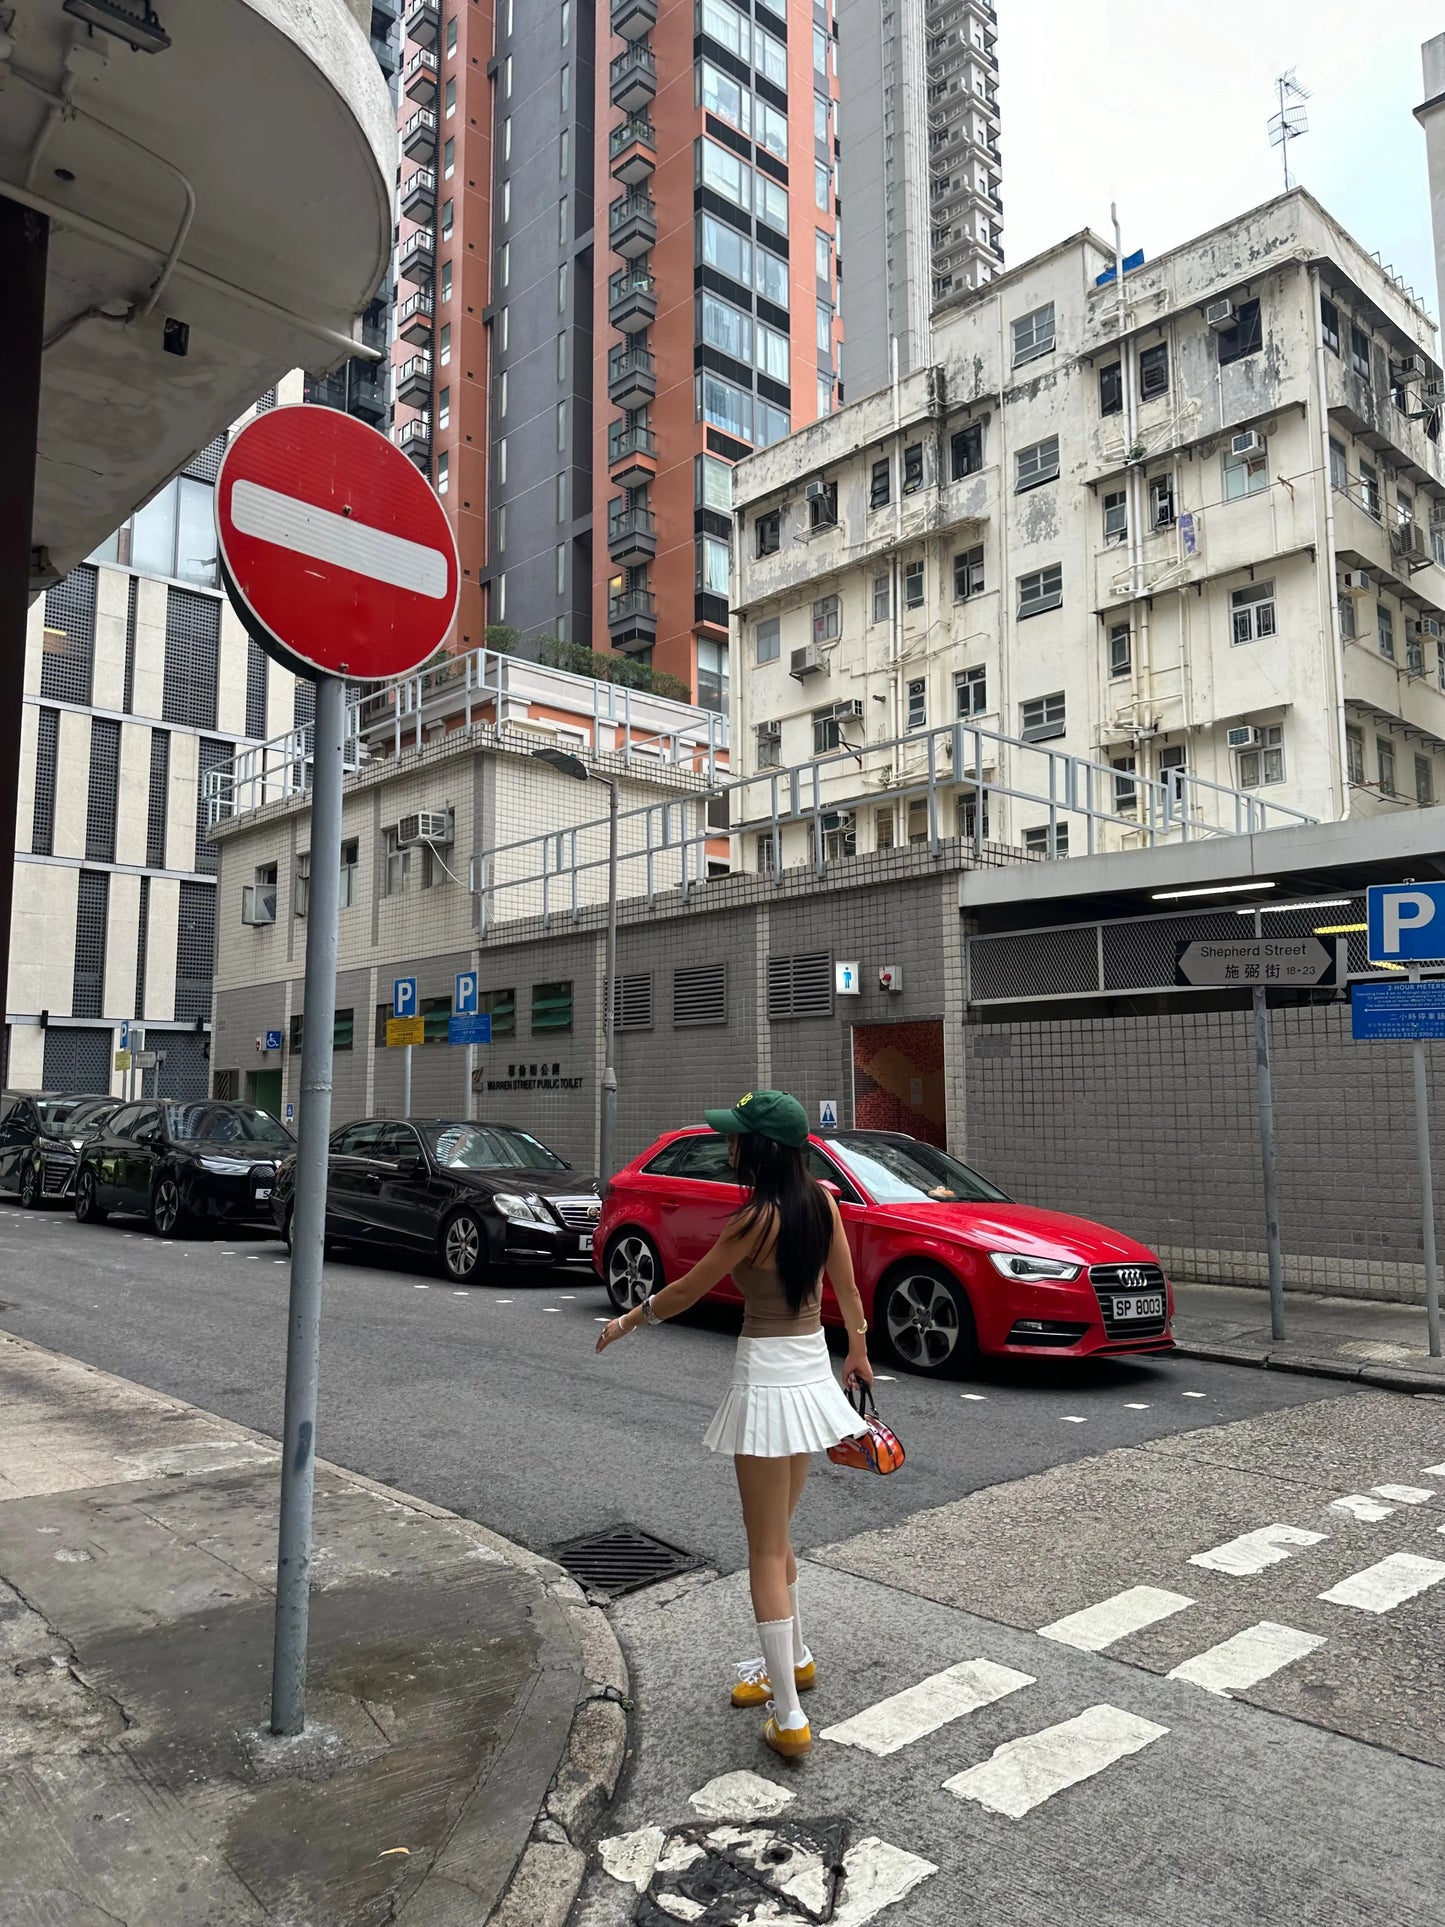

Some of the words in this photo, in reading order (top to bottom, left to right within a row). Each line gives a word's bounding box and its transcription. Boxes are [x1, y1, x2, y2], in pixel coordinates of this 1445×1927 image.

[1383, 892, 1436, 953] P
[1200, 945, 1260, 959] Shepherd
[1264, 943, 1307, 956] Street
[1224, 963, 1281, 979] 施弼街
[1286, 966, 1317, 976] 18-23
[397, 982, 413, 1014] P
[459, 977, 474, 1010] P
[487, 1080, 512, 1091] WARREN
[513, 1080, 537, 1090] STREET
[537, 1079, 561, 1089] PUBLIC
[561, 1078, 583, 1088] TOILET
[1116, 1300, 1132, 1317] SP
[1136, 1298, 1161, 1315] 8003
